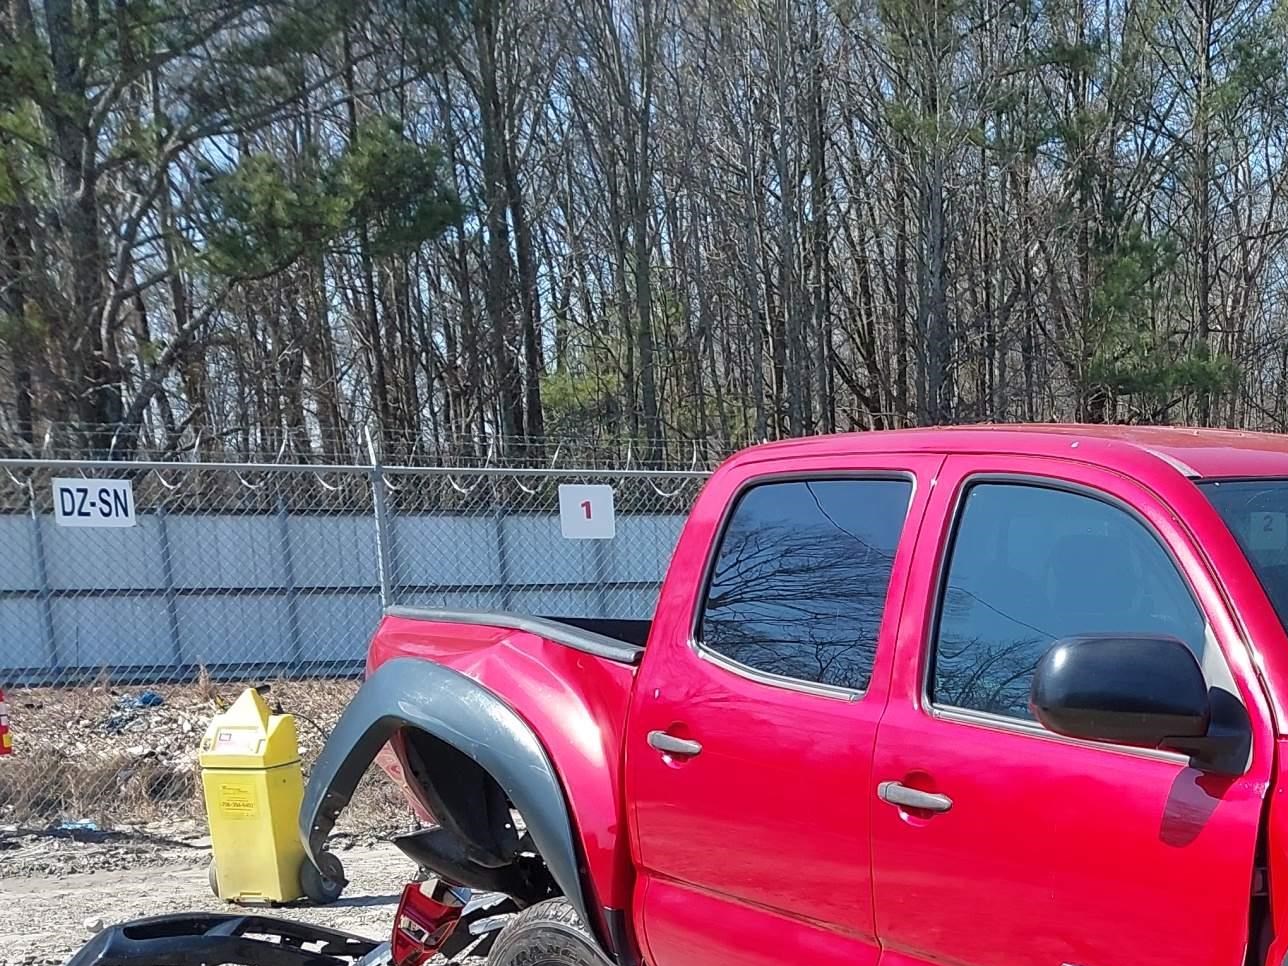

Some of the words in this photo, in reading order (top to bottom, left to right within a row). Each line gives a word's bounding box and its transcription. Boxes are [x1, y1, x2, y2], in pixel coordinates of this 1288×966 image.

[60, 487, 129, 518] DZ-SN
[581, 501, 592, 520] 1
[1263, 514, 1273, 532] 2
